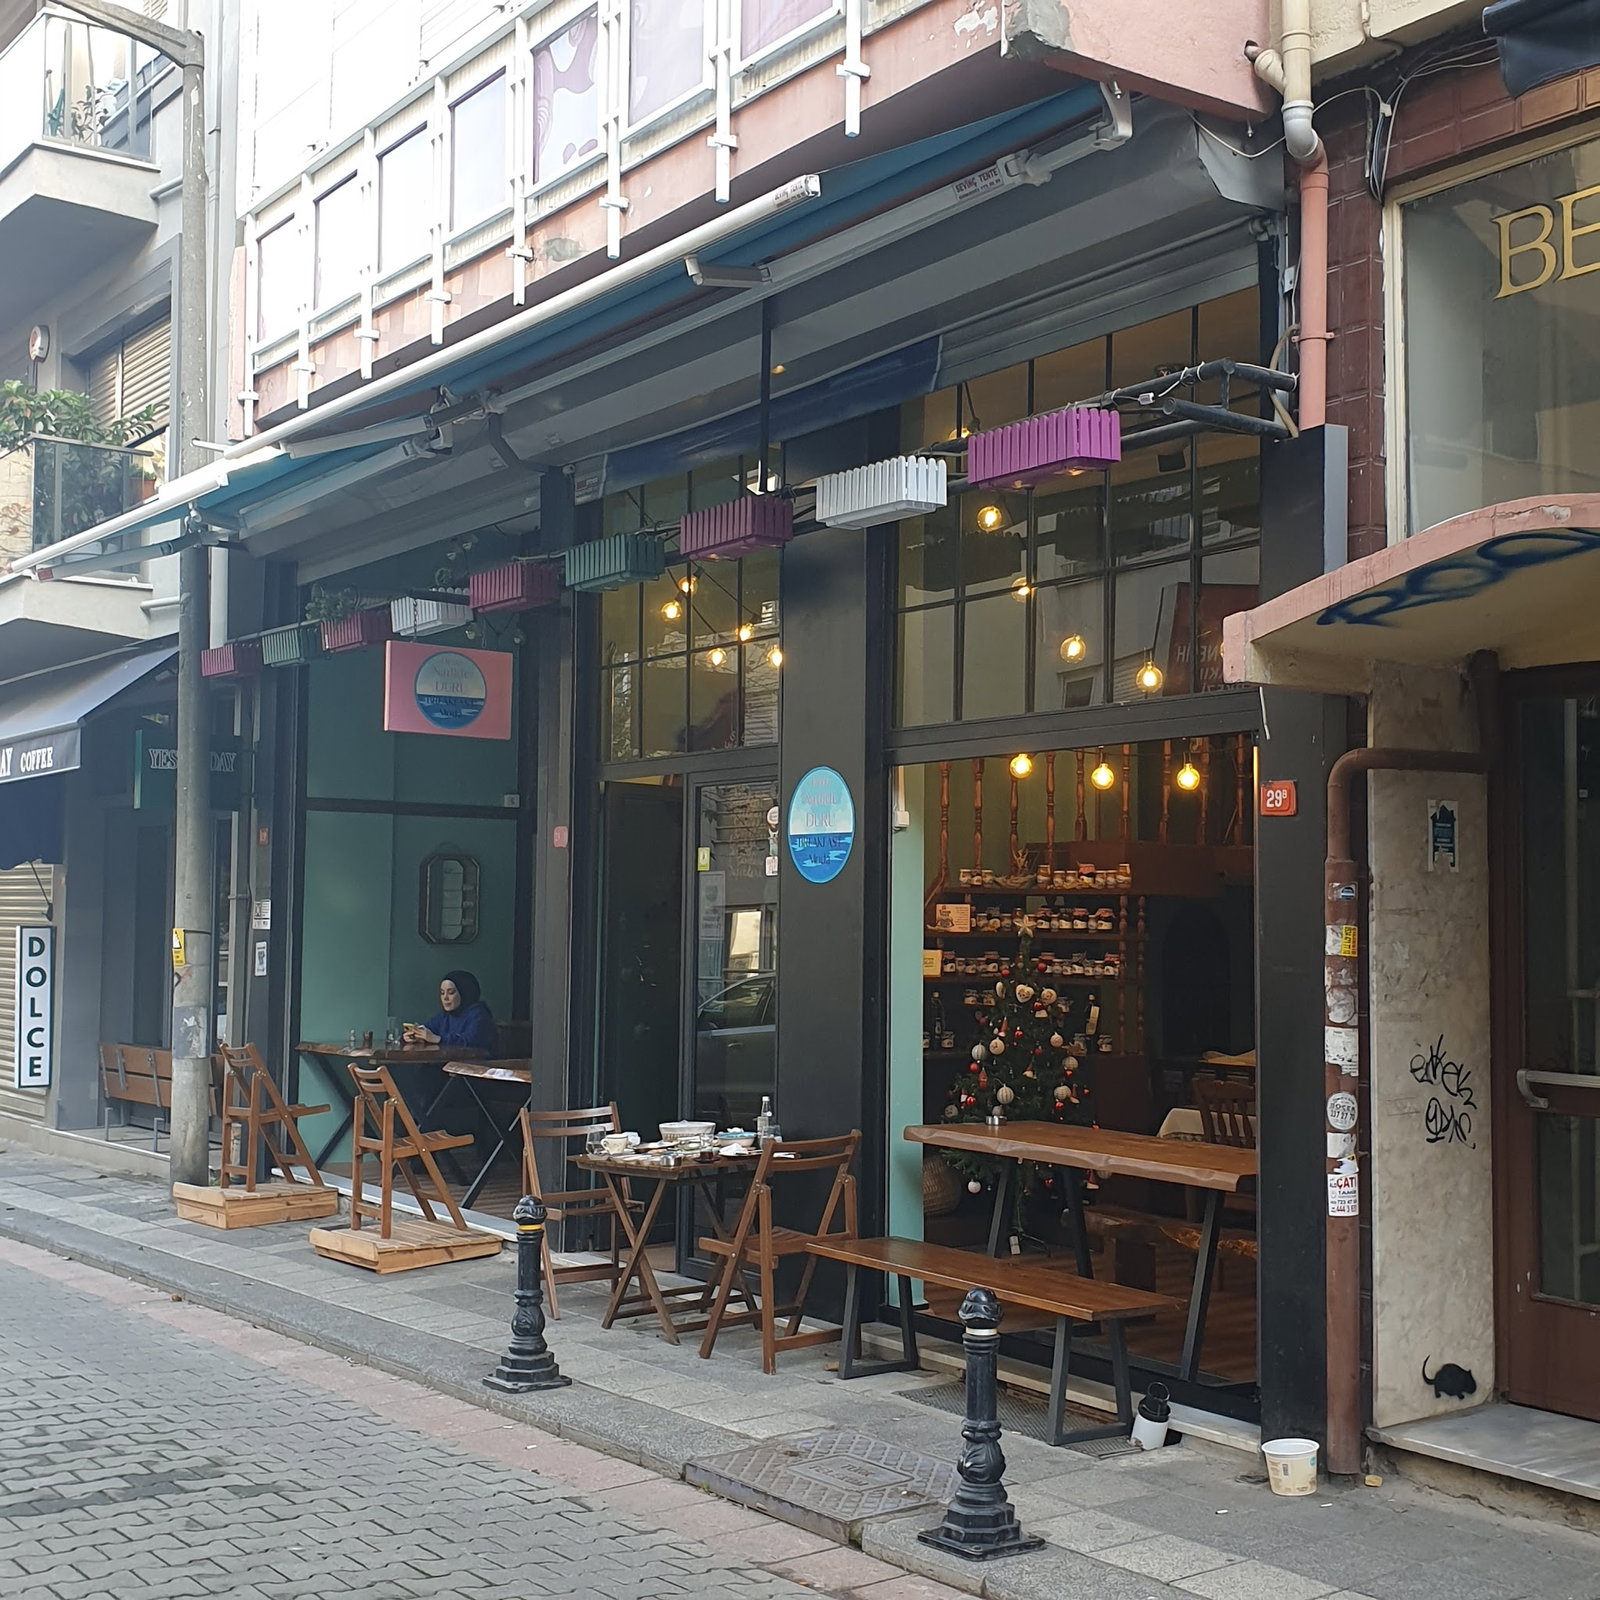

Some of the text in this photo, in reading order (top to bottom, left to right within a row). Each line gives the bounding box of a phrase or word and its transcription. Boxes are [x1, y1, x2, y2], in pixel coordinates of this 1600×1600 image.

[978, 167, 999, 182] TENTE
[20, 746, 53, 773] COFFEE
[148, 748, 237, 772] YESDAY
[25, 936, 47, 1077] DOLCE
[1337, 1176, 1357, 1189] ÇATI
